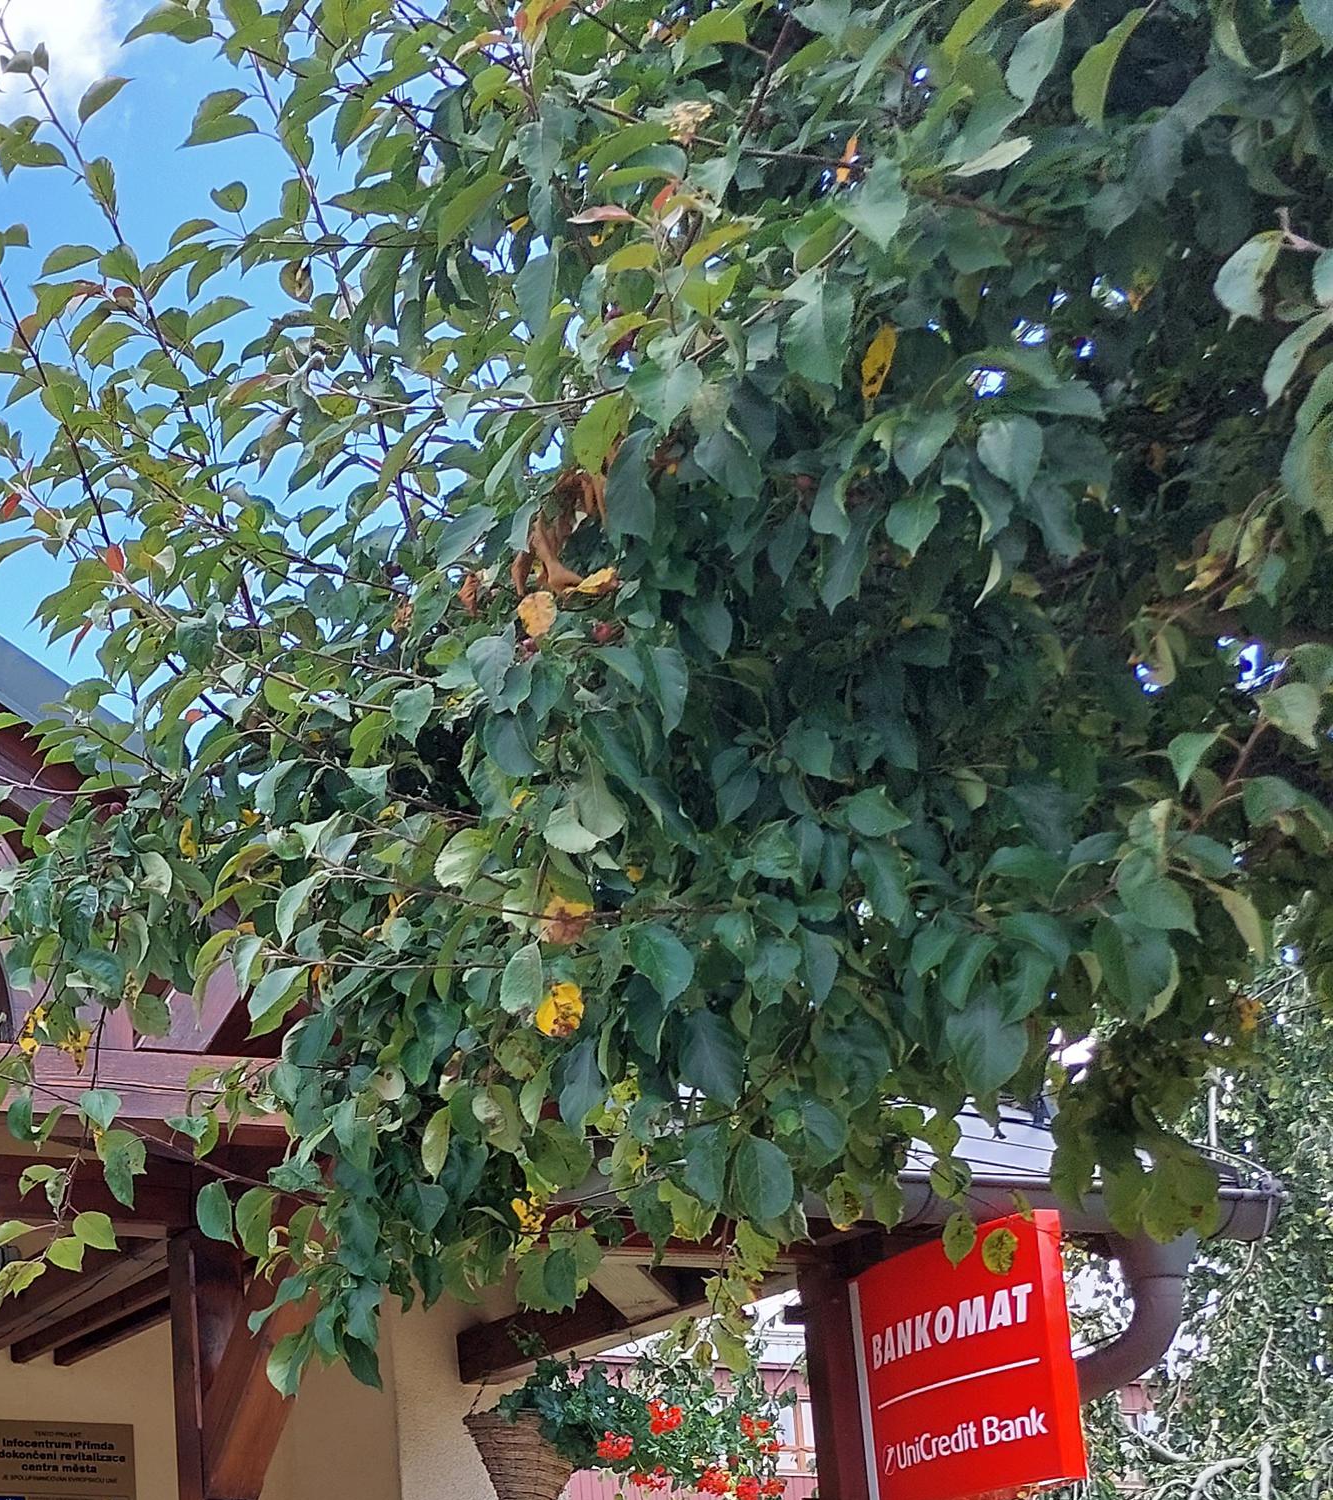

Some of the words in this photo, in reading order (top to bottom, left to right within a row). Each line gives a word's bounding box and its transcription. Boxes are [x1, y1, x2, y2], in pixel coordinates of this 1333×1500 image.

[872, 1283, 1033, 1370] BANKOMAT
[2, 1438, 72, 1449] Infocentrum
[896, 1421, 978, 1470] UniCredit
[982, 1406, 1050, 1446] Bank
[60, 1452, 126, 1462] revitalizace
[21, 1463, 59, 1472] centra
[62, 1464, 97, 1473] města
